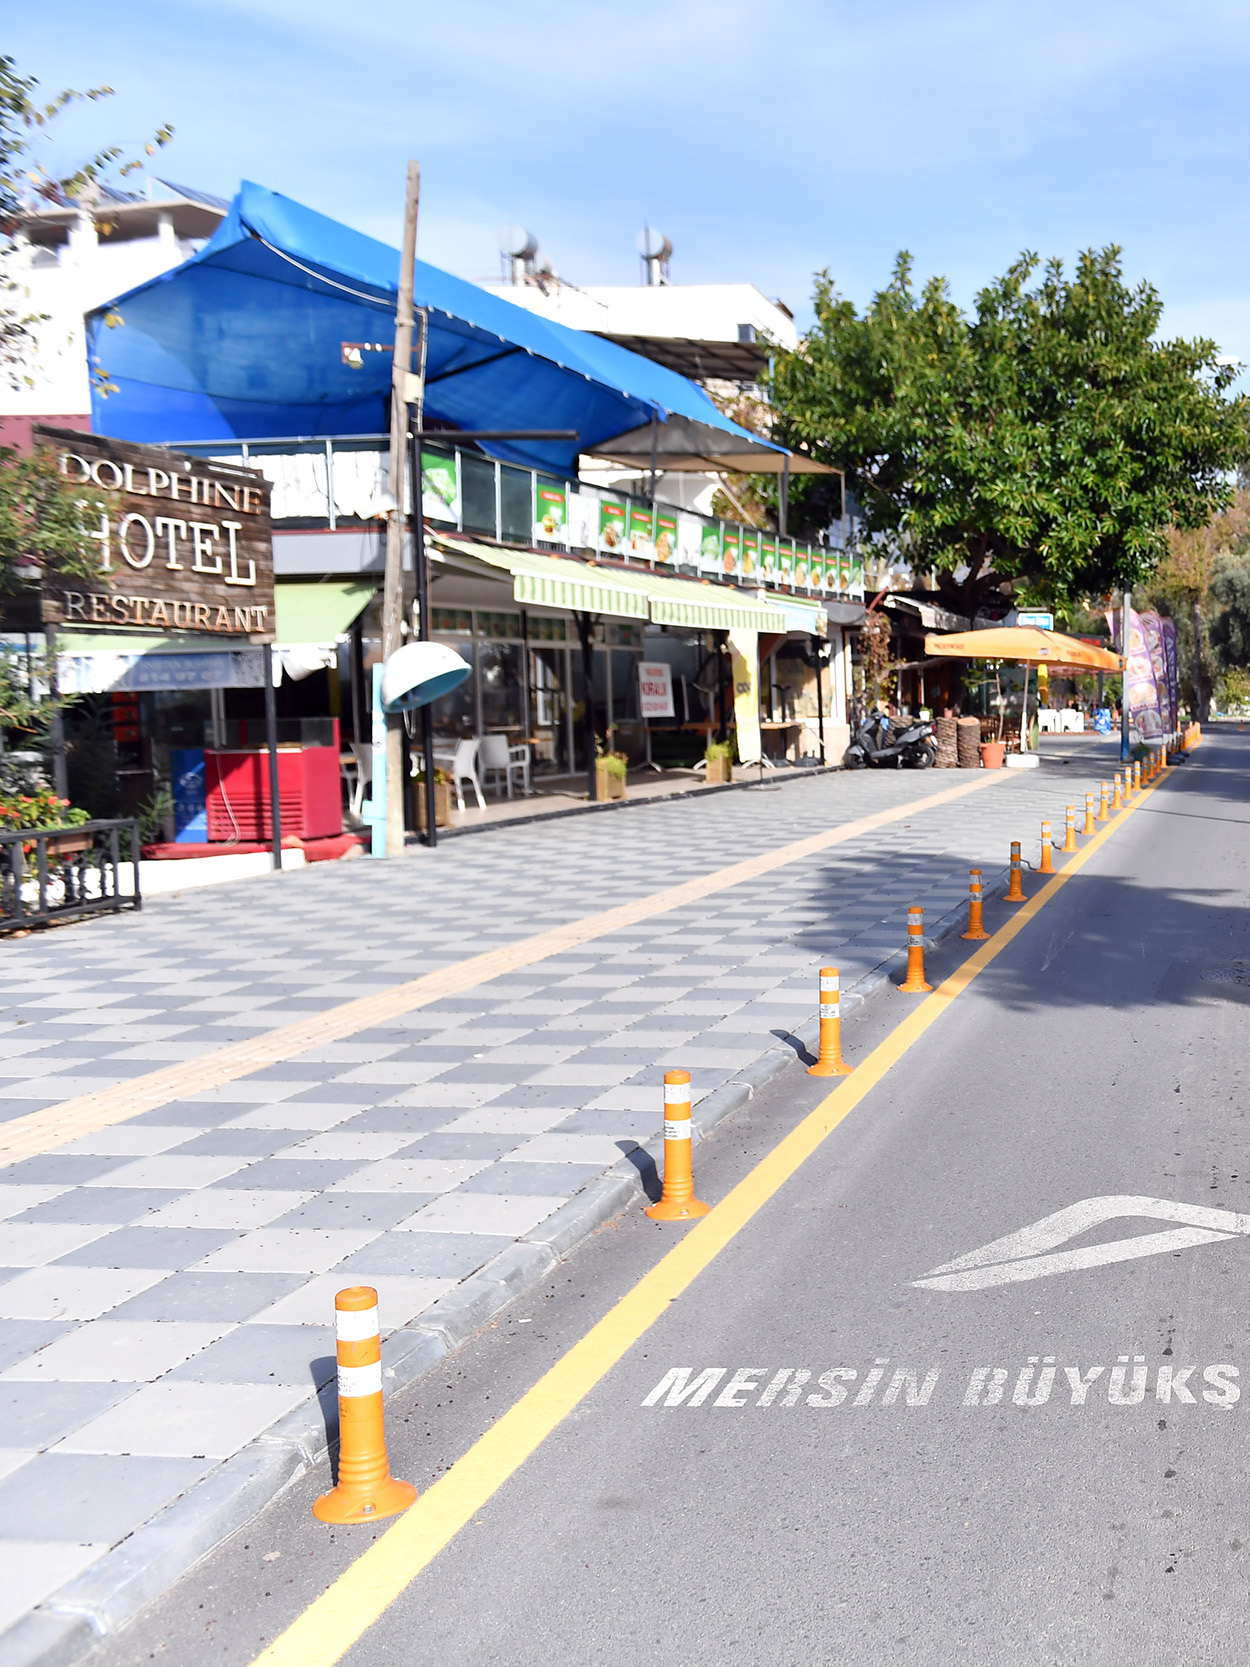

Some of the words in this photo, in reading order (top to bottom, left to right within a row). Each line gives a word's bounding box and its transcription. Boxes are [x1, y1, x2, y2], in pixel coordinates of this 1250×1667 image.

[57, 453, 264, 516] DOLPHINE
[63, 590, 269, 633] RESTAURANT
[640, 1357, 941, 1408] MERSİN
